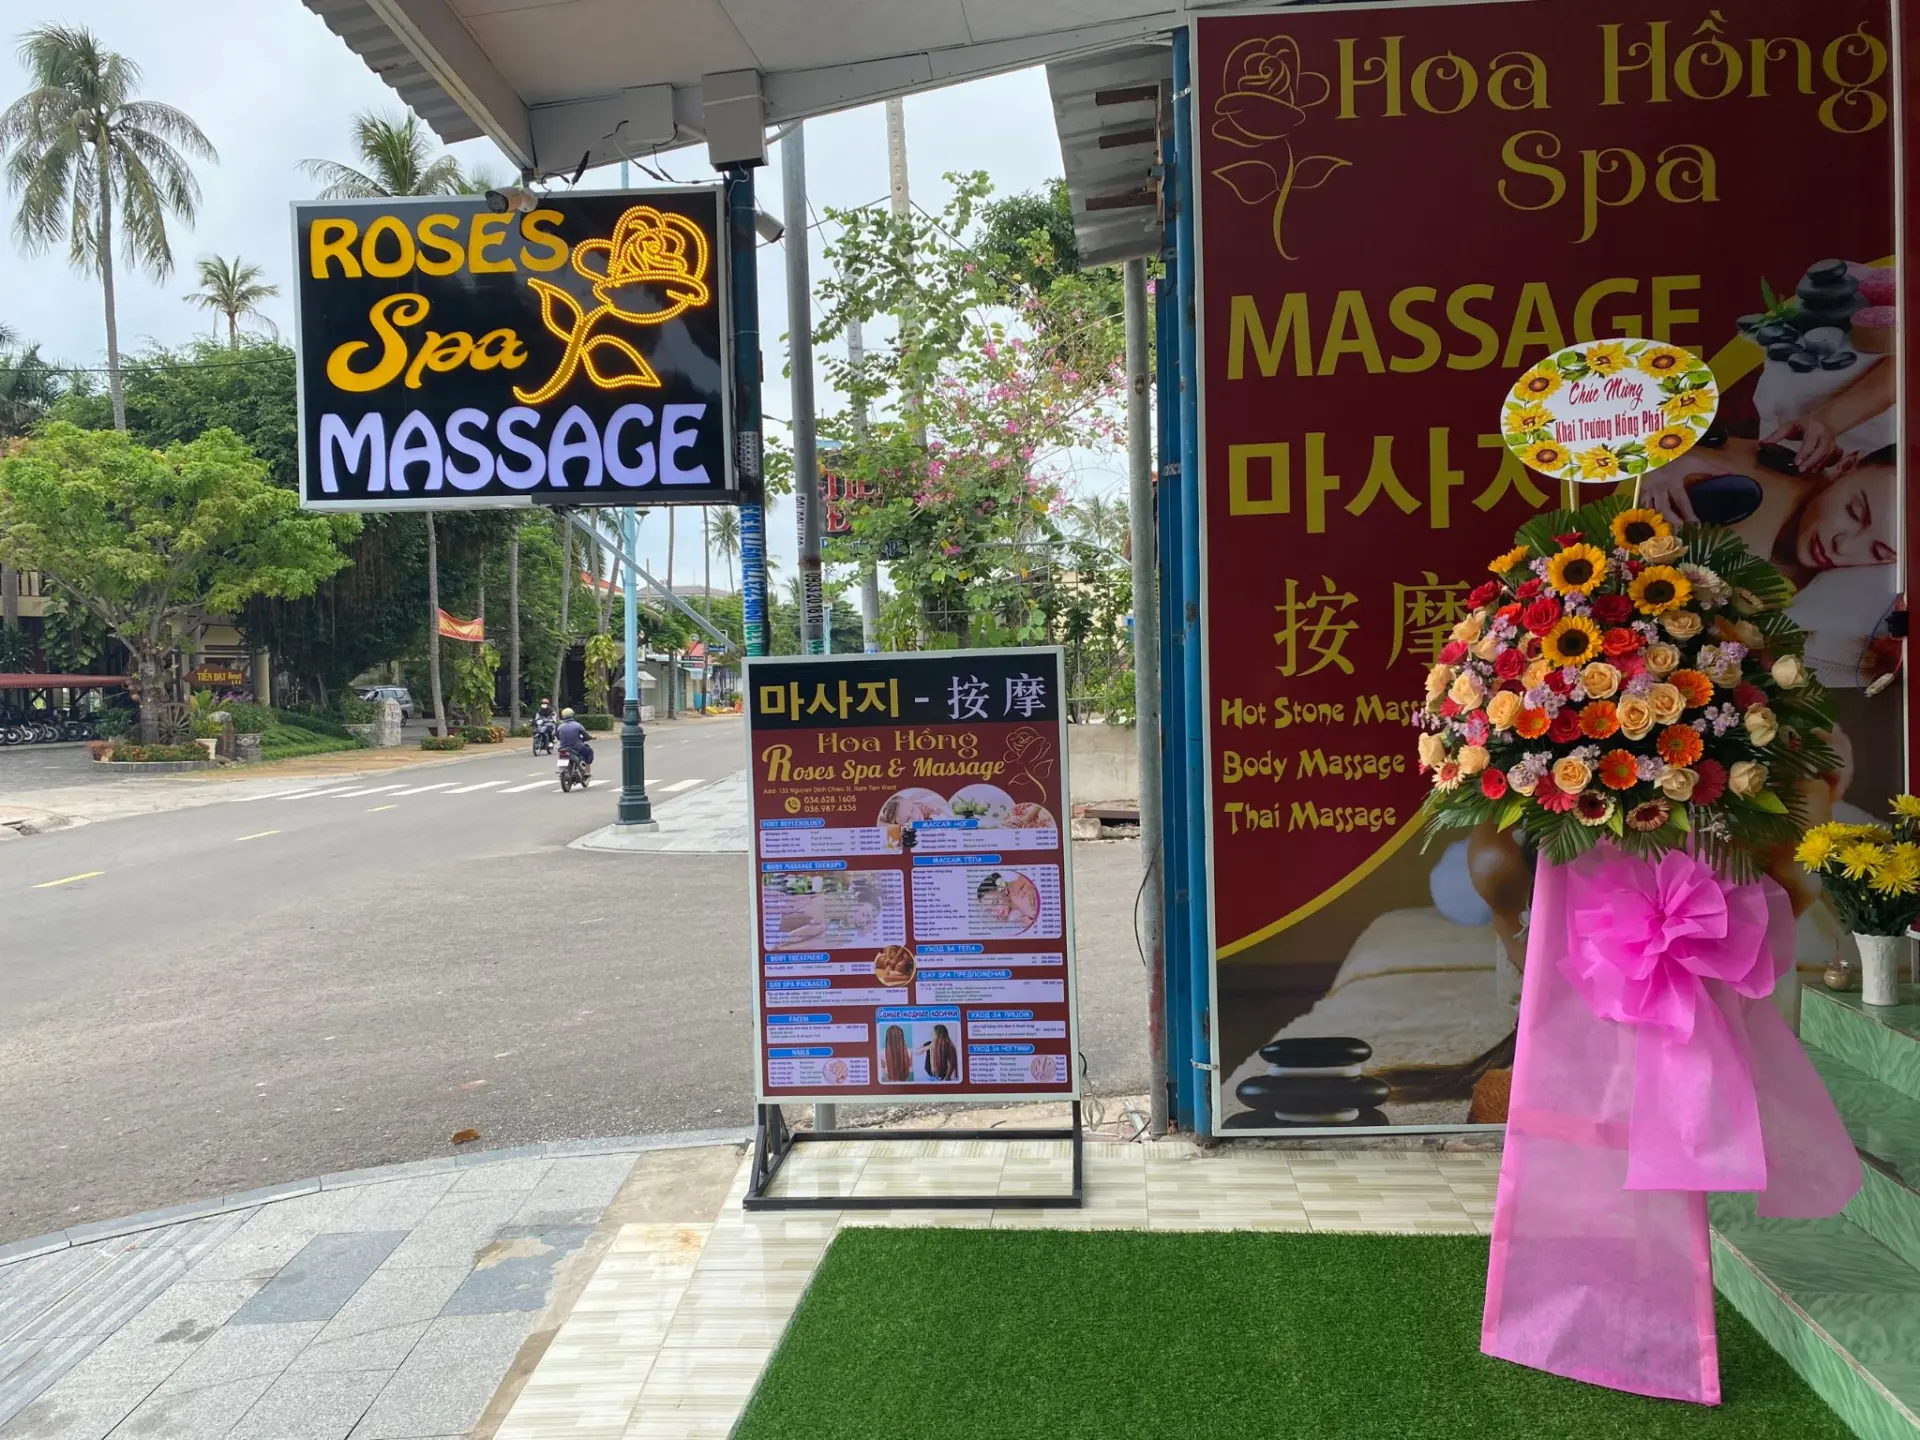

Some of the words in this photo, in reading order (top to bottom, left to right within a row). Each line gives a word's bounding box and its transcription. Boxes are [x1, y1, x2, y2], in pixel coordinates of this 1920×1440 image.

[1333, 34, 1551, 120] Hoa
[1597, 9, 1889, 133] Hồng
[1496, 129, 1721, 244] Spa
[309, 209, 570, 279] ROSES
[326, 292, 528, 392] Spa
[1226, 274, 1703, 382] MASSAGE
[1568, 381, 1600, 405] Chúc
[1603, 377, 1644, 410] Mừng
[319, 403, 711, 493] MASSAGE
[1555, 420, 1576, 443] Khai
[760, 678, 899, 721] 마사지
[947, 672, 1047, 719] 按摩
[1221, 697, 1267, 730] Hot
[1274, 696, 1345, 729] Stone
[761, 743, 836, 782] Roses
[841, 759, 884, 785] Spa
[888, 758, 906, 778] &
[912, 757, 1006, 781] Massage
[817, 732, 882, 754] Hoa
[894, 727, 978, 759] Hồng
[1222, 750, 1288, 783] Body
[1296, 748, 1406, 781] Massage
[1223, 802, 1280, 836] Thai
[1288, 801, 1397, 833] Massage
